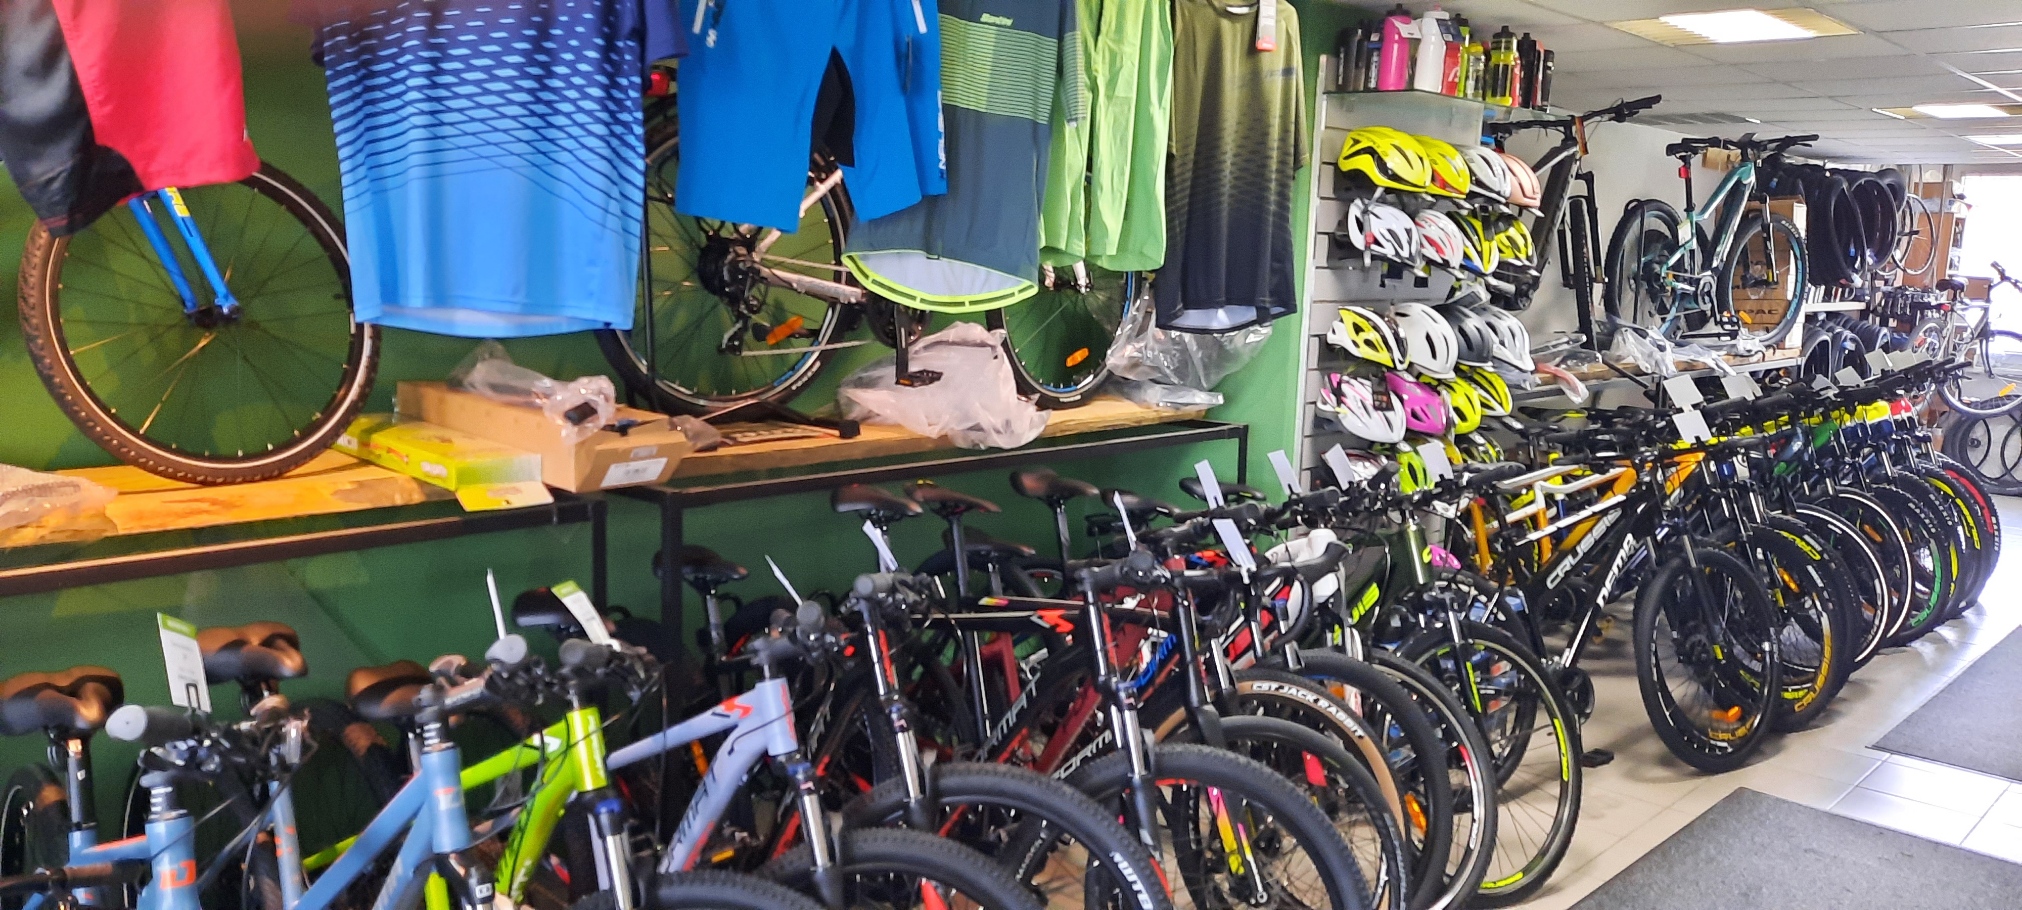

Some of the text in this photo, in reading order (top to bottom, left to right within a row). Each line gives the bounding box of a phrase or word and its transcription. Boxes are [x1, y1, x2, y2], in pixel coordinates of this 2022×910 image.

[1546, 507, 1623, 590] CRUSSIS
[1252, 682, 1366, 738] CST JACK RABBIT
